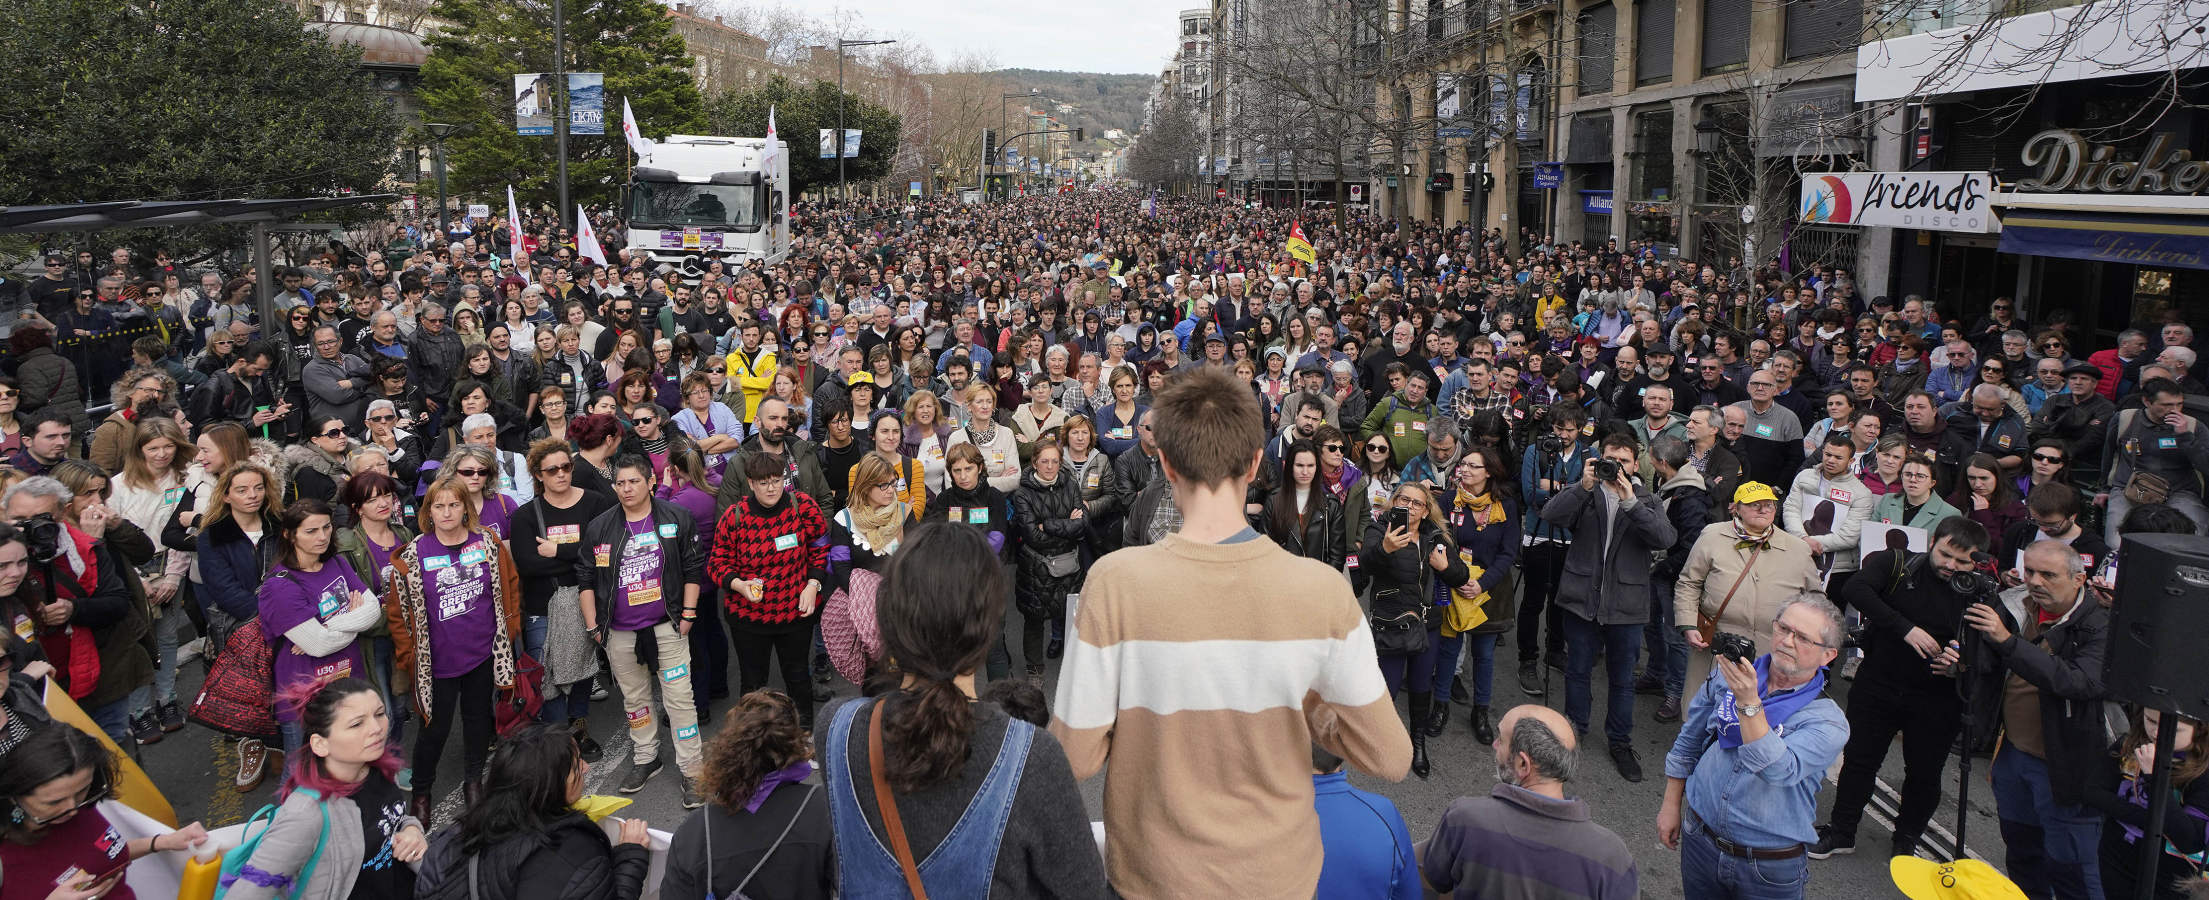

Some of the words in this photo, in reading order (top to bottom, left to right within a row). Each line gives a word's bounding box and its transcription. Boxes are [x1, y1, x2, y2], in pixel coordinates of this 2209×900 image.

[1589, 196, 1613, 208] Allianz
[1853, 173, 1985, 225] friends
[1904, 214, 1978, 228] DISCO
[620, 560, 660, 577] GREBAN!
[440, 587, 484, 609] GREBAN!
[667, 667, 685, 678] ELA
[680, 727, 697, 737] ELA
